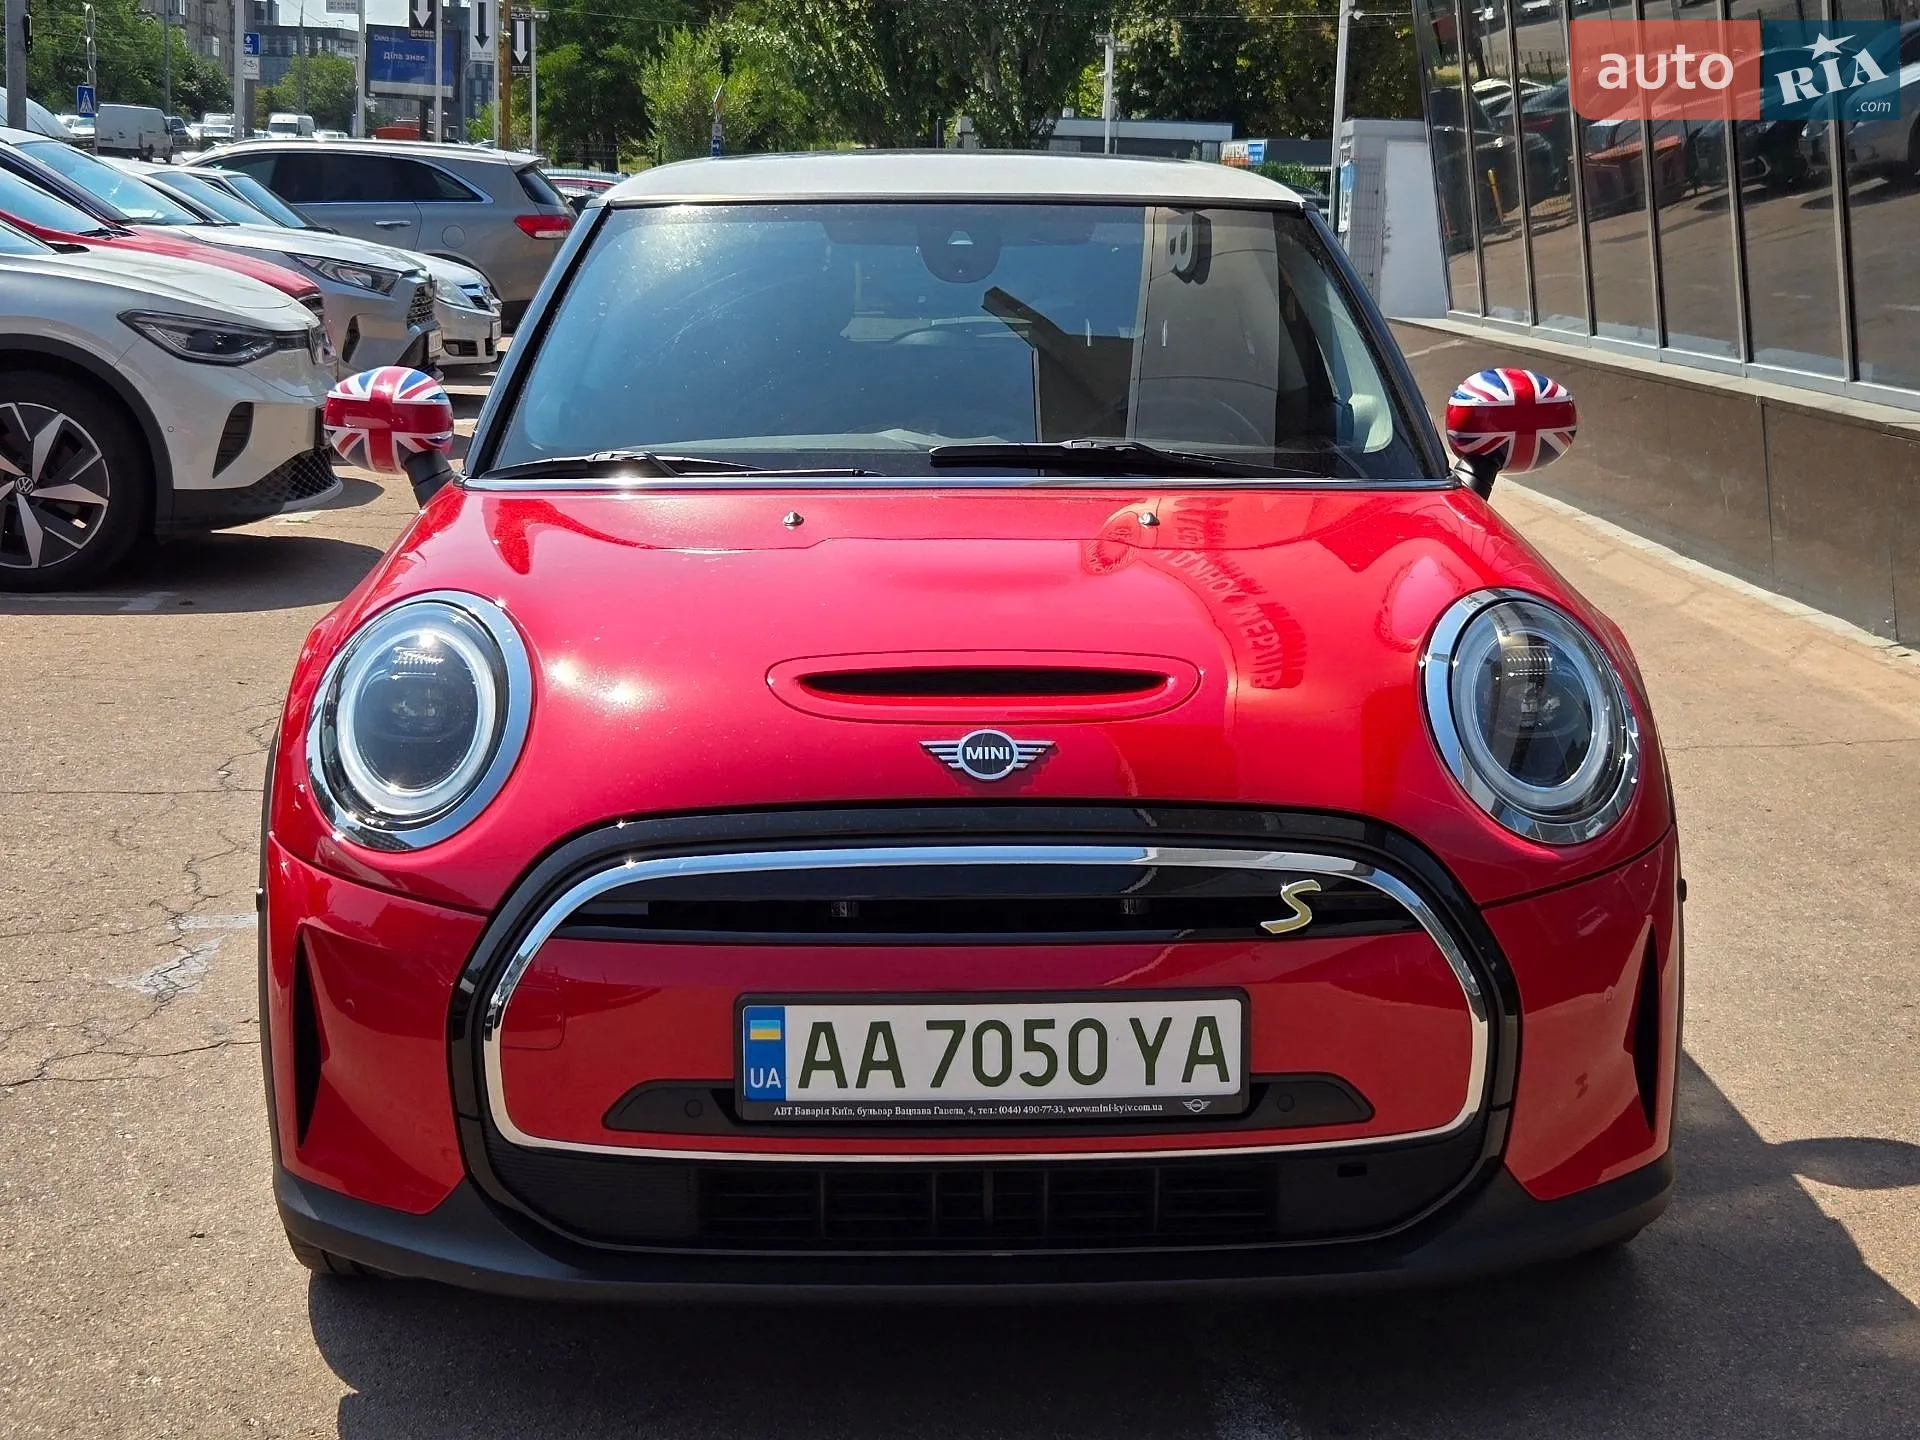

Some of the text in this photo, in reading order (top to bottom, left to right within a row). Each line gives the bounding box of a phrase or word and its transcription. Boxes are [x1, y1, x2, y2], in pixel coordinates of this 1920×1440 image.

[966, 746, 1011, 760] MINI
[1260, 880, 1322, 934] S
[798, 1015, 1231, 1089] AA 7050 YA
[750, 1067, 782, 1088] UA
[999, 1104, 1021, 1115] (044)
[1067, 1101, 1163, 1114] www.mini-kyiv.com.ua
